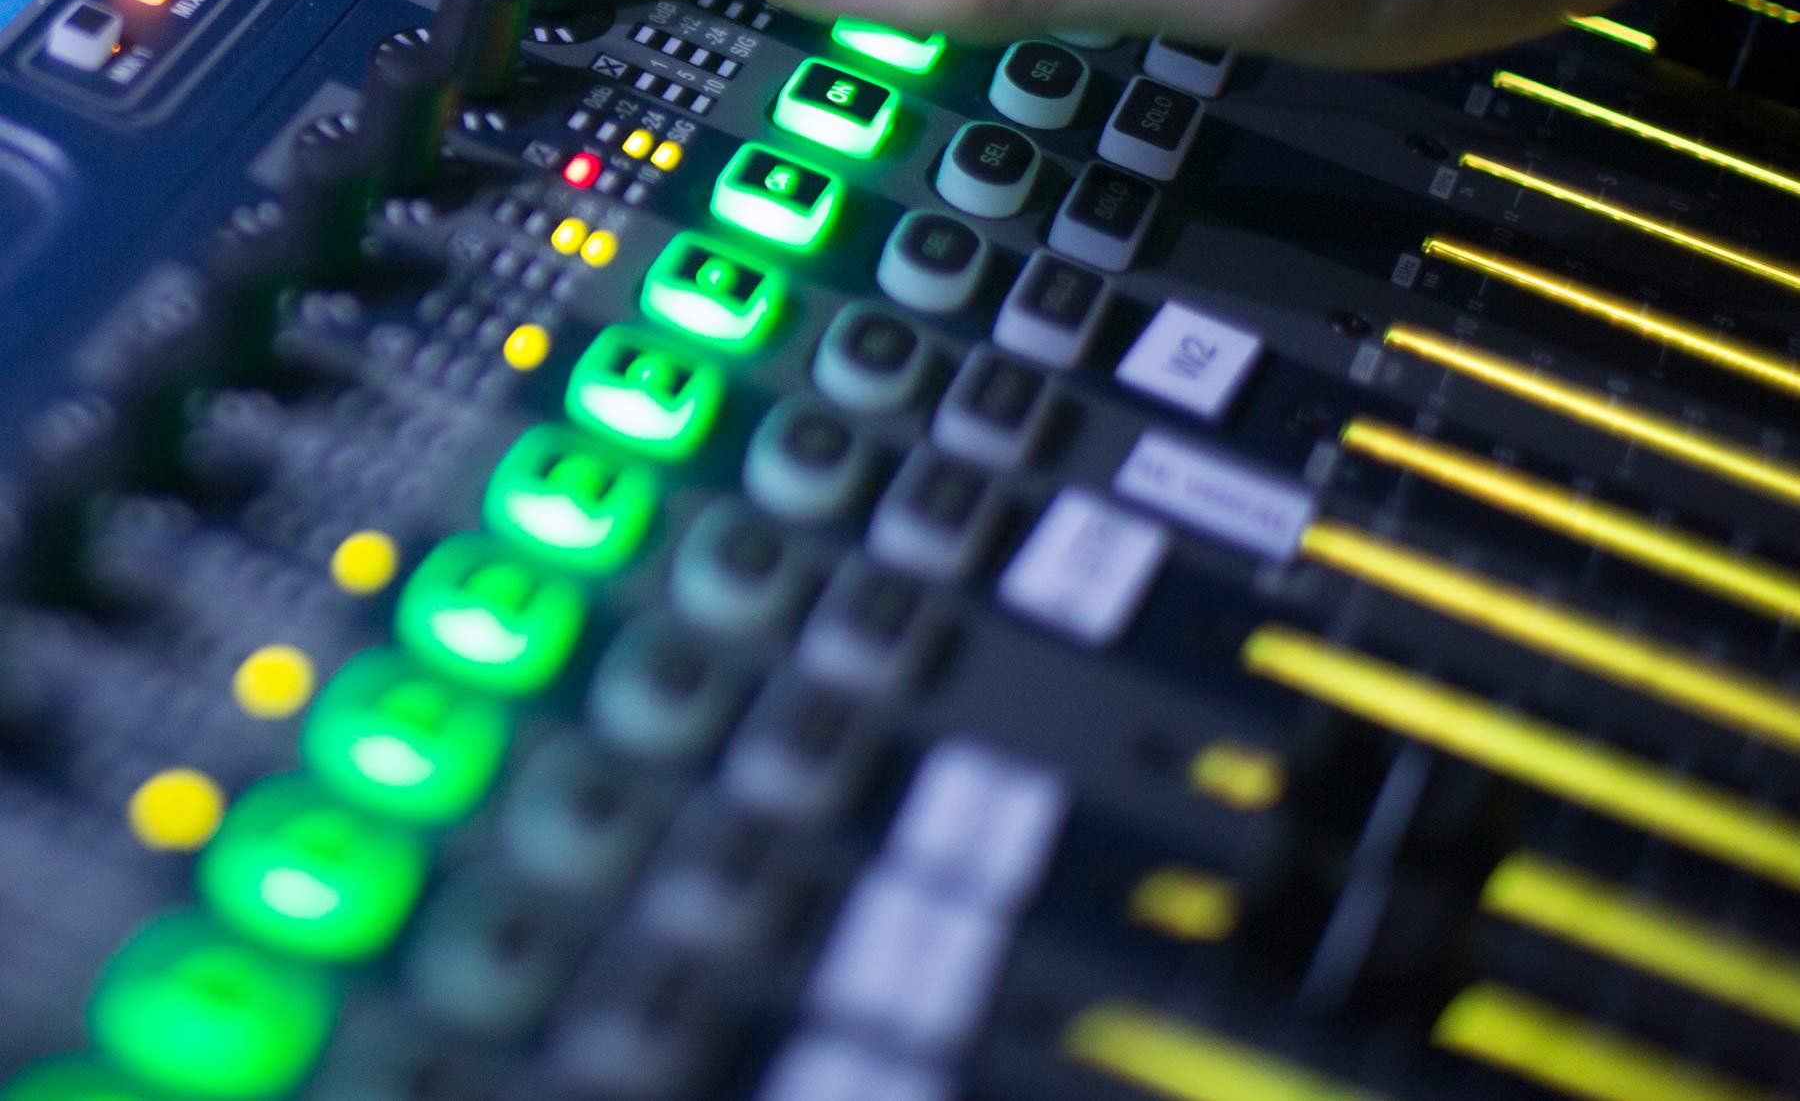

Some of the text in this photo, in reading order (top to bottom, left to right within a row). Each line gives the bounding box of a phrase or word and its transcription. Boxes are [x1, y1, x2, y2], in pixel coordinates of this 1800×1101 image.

[648, 1, 677, 24] 0dB
[680, 16, 702, 35] -12
[705, 26, 728, 45] -24
[730, 35, 758, 58] SIG
[650, 59, 668, 69] 1
[677, 69, 696, 82] 5
[1031, 58, 1059, 82] SEL
[702, 79, 726, 95] 10
[826, 79, 857, 104] ON
[1141, 95, 1174, 132] SOLO
[667, 119, 696, 144] SIG
[980, 142, 1009, 168] SEL
